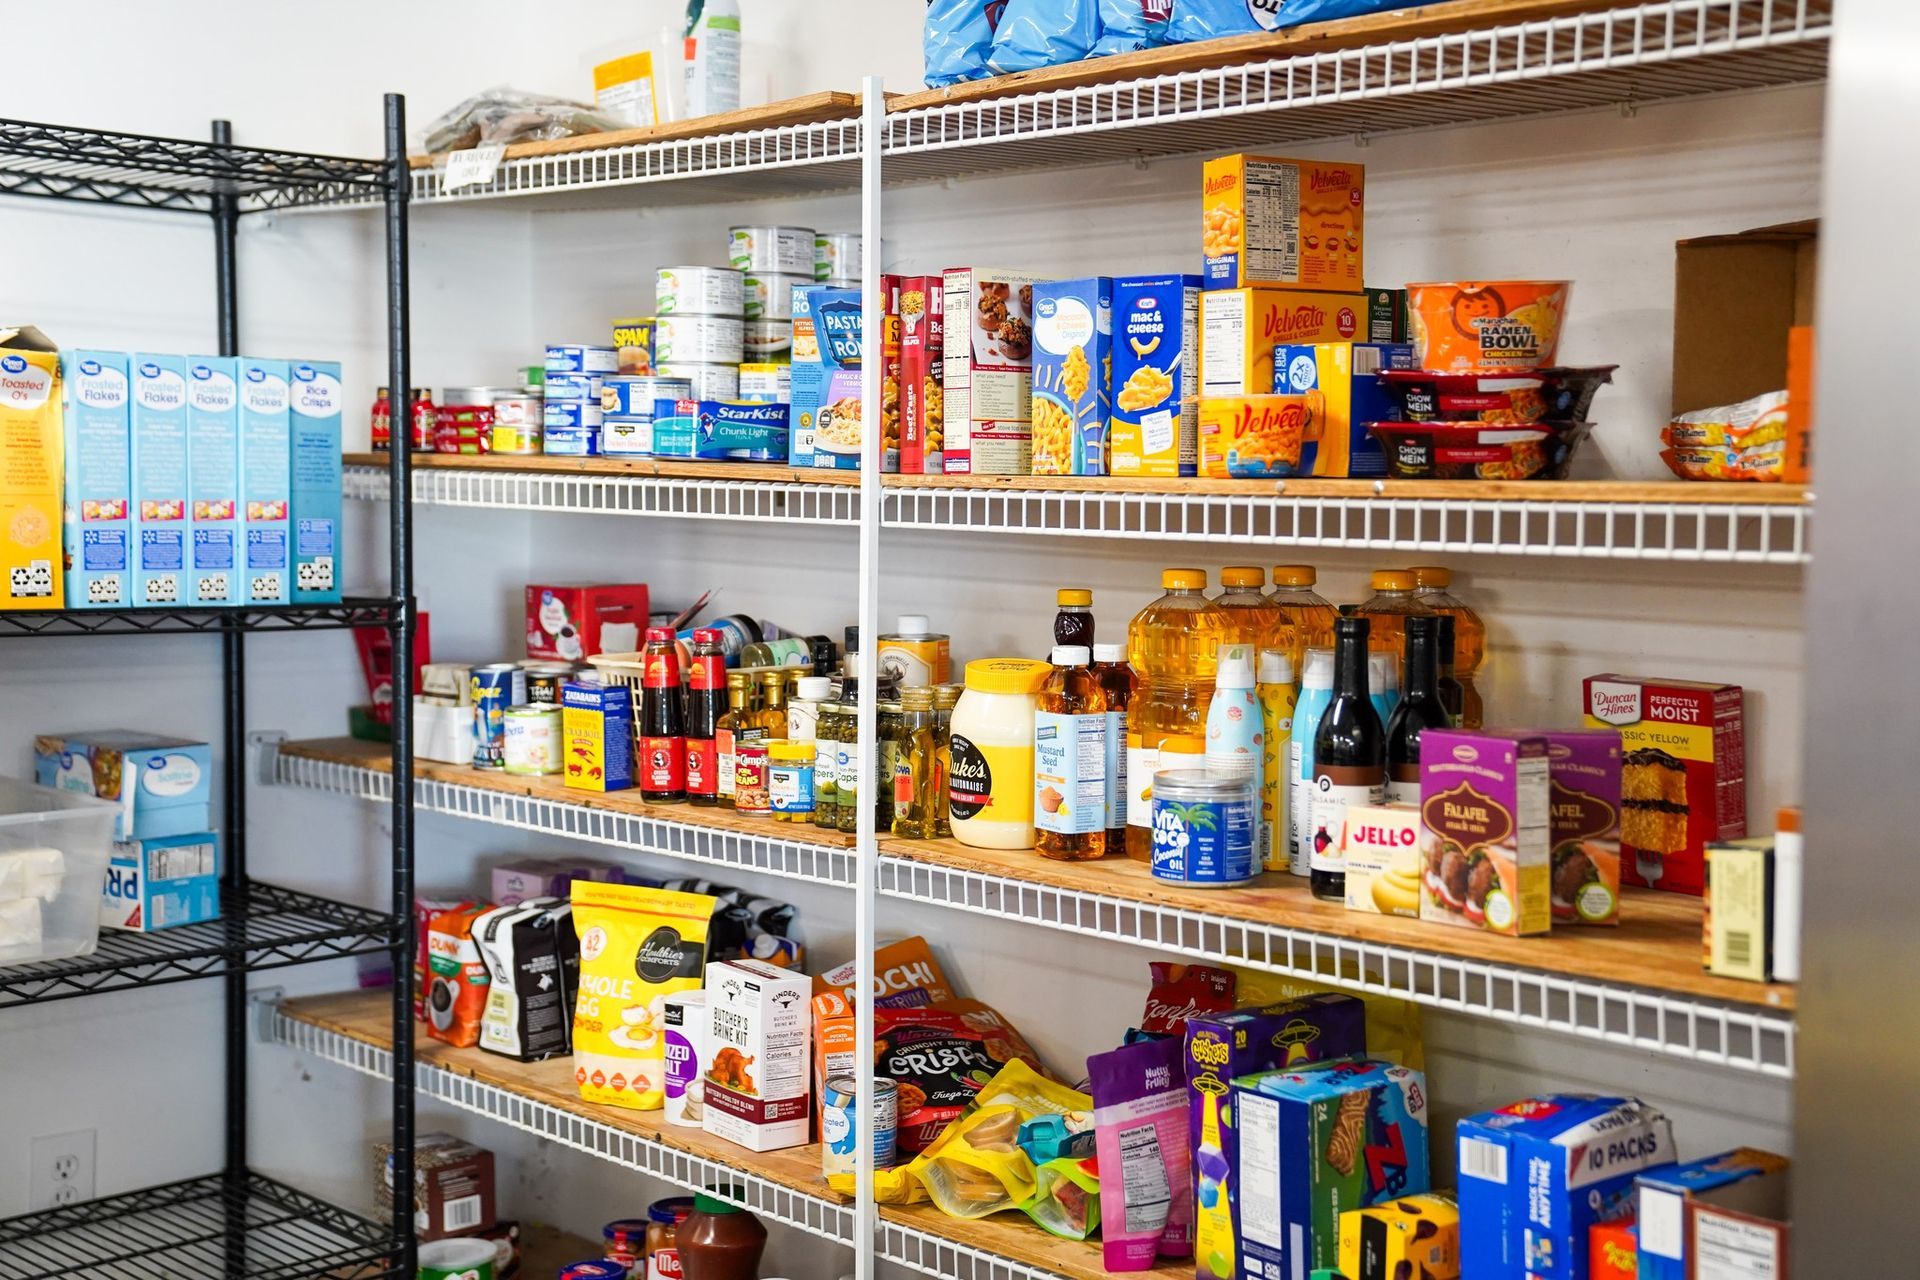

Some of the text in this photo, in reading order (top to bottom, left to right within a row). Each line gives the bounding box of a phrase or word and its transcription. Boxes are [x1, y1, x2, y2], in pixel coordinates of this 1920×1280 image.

[1205, 174, 1238, 195] Velveeta
[1310, 168, 1352, 191] Velveeta
[1206, 256, 1236, 265] ORIGINAL
[793, 290, 807, 300] PA
[1131, 310, 1162, 323] mac &
[1264, 304, 1327, 338] Velveeta
[1342, 314, 1351, 326] 10
[1272, 333, 1292, 343] SHELLS
[1299, 328, 1320, 339] CHEESE
[1481, 326, 1531, 335] RAMEN
[613, 326, 648, 349] SPAM
[1481, 335, 1539, 348] BOWL
[1, 378, 45, 391] Toasted
[306, 386, 328, 396] Rice
[11, 389, 28, 401] O's
[85, 390, 120, 401] Flakes
[144, 392, 178, 404] Flakes
[196, 393, 229, 405] Flakes
[250, 395, 282, 407] Flakes
[1406, 393, 1431, 403] CHOW
[301, 396, 331, 408] Crisps
[1407, 402, 1432, 411] MEIN
[717, 407, 784, 421] StarKist
[719, 426, 769, 438] Chunk Light
[1398, 446, 1426, 454] CHOW
[1399, 454, 1426, 464] MEIN
[1594, 691, 1637, 706] Duncan
[1650, 695, 1699, 708] PERFECTLY
[1600, 702, 1636, 717] Hines
[1650, 705, 1700, 722] MOIST
[1650, 733, 1690, 745] YELLOW
[1037, 743, 1065, 757] Mustard
[1042, 755, 1058, 767] Seed
[1444, 802, 1490, 822] FALAFEL
[1154, 808, 1185, 832] VITA
[1153, 829, 1190, 848] COCO
[1354, 826, 1416, 847] JELL-O
[1169, 860, 1184, 870] OIL
[637, 941, 685, 962] Healthier
[640, 955, 680, 967] COMFORTS
[772, 990, 801, 1003] KINDERS
[713, 1006, 749, 1031] BUTCHER'S
[713, 1021, 748, 1047] BRINE KIT
[766, 1032, 789, 1040] Nutrition
[1235, 1030, 1247, 1045] 20
[664, 1043, 690, 1062] IZED
[895, 1040, 943, 1057] CRUNCHY
[1191, 1037, 1229, 1065] Gushers
[766, 1051, 792, 1060] Calories
[1145, 1065, 1169, 1079] Nutty
[1145, 1078, 1170, 1090] Fruity
[931, 1090, 961, 1102] Fuego
[1317, 1103, 1327, 1122] 24
[1120, 1123, 1154, 1138] Nutrition Facts
[1122, 1151, 1141, 1160] Calories
[1589, 1133, 1657, 1170] 10 PACKS
[659, 1253, 681, 1271] Me
